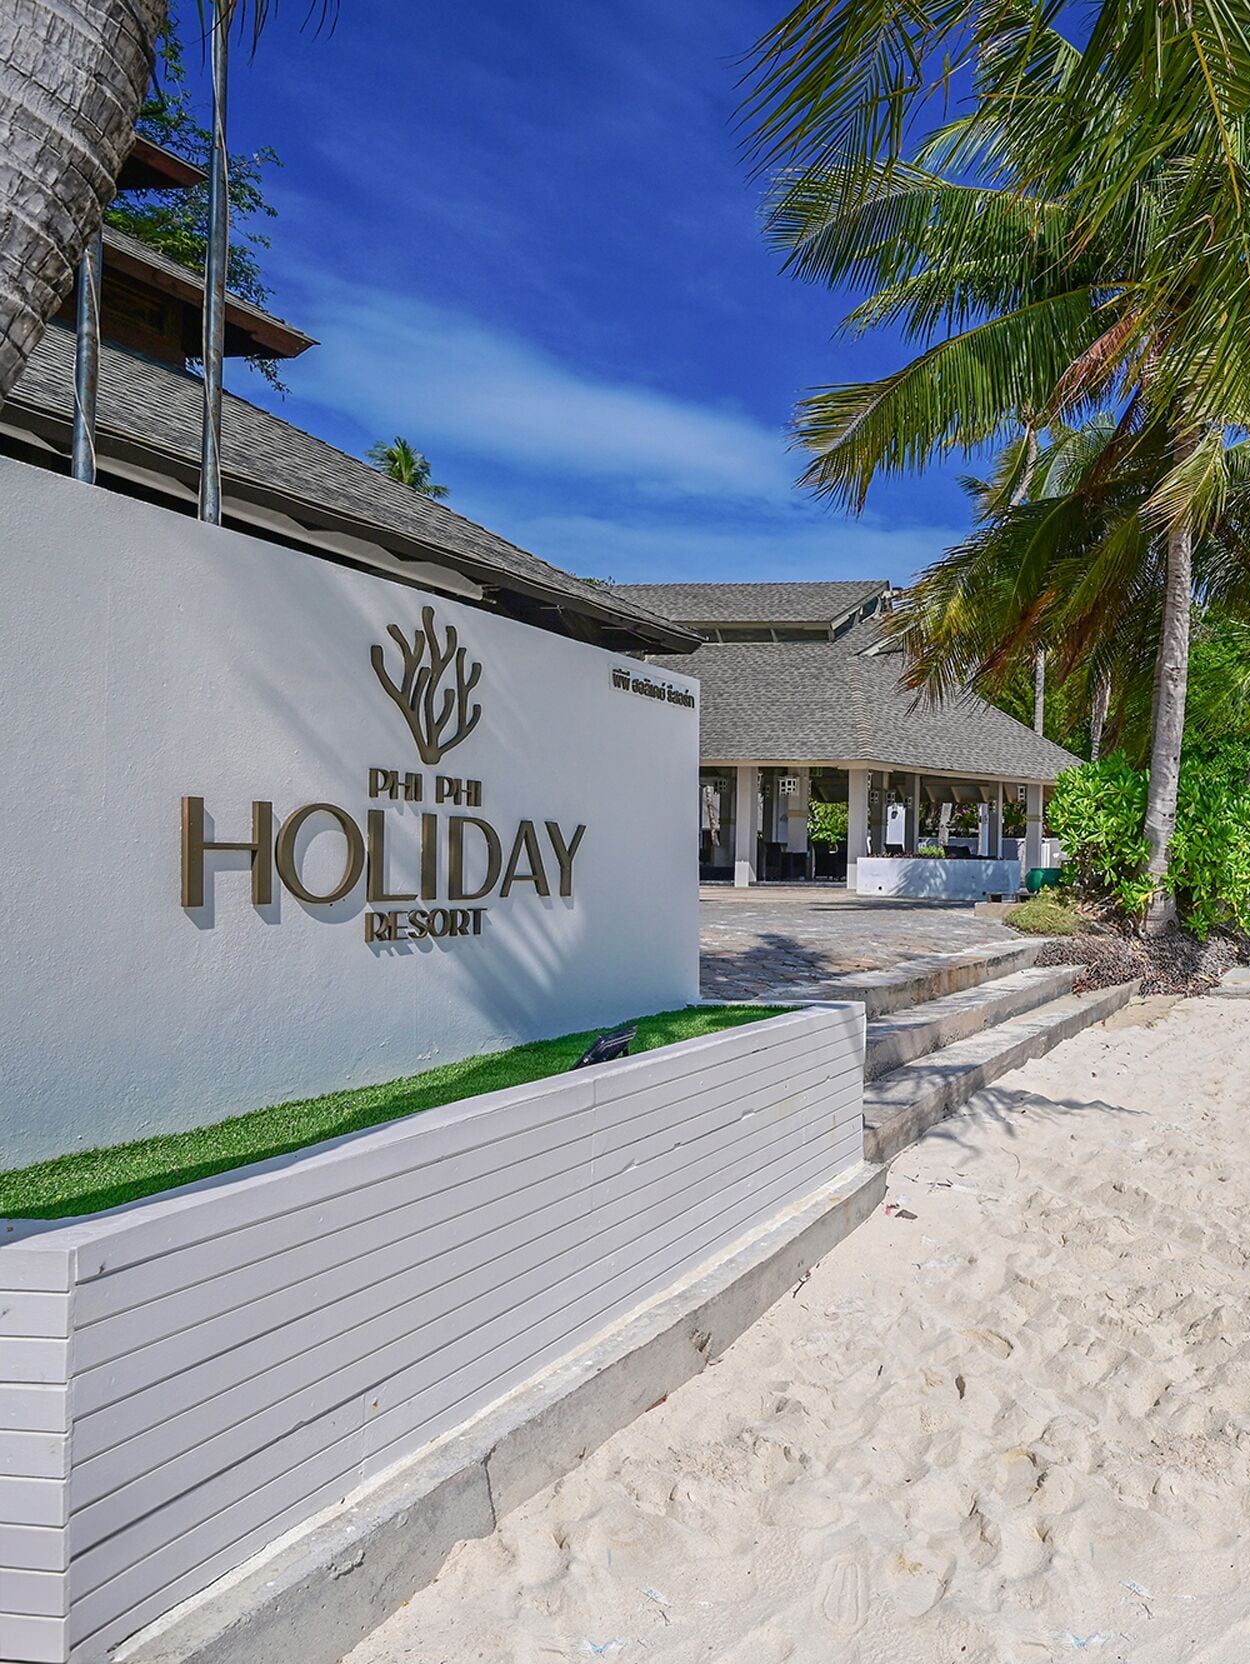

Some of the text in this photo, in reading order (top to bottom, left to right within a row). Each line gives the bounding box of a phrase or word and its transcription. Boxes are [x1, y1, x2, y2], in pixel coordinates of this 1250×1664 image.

[369, 767, 483, 807] PHI PHI
[180, 795, 587, 908] HOLIDAY
[364, 907, 488, 942] RESORT
